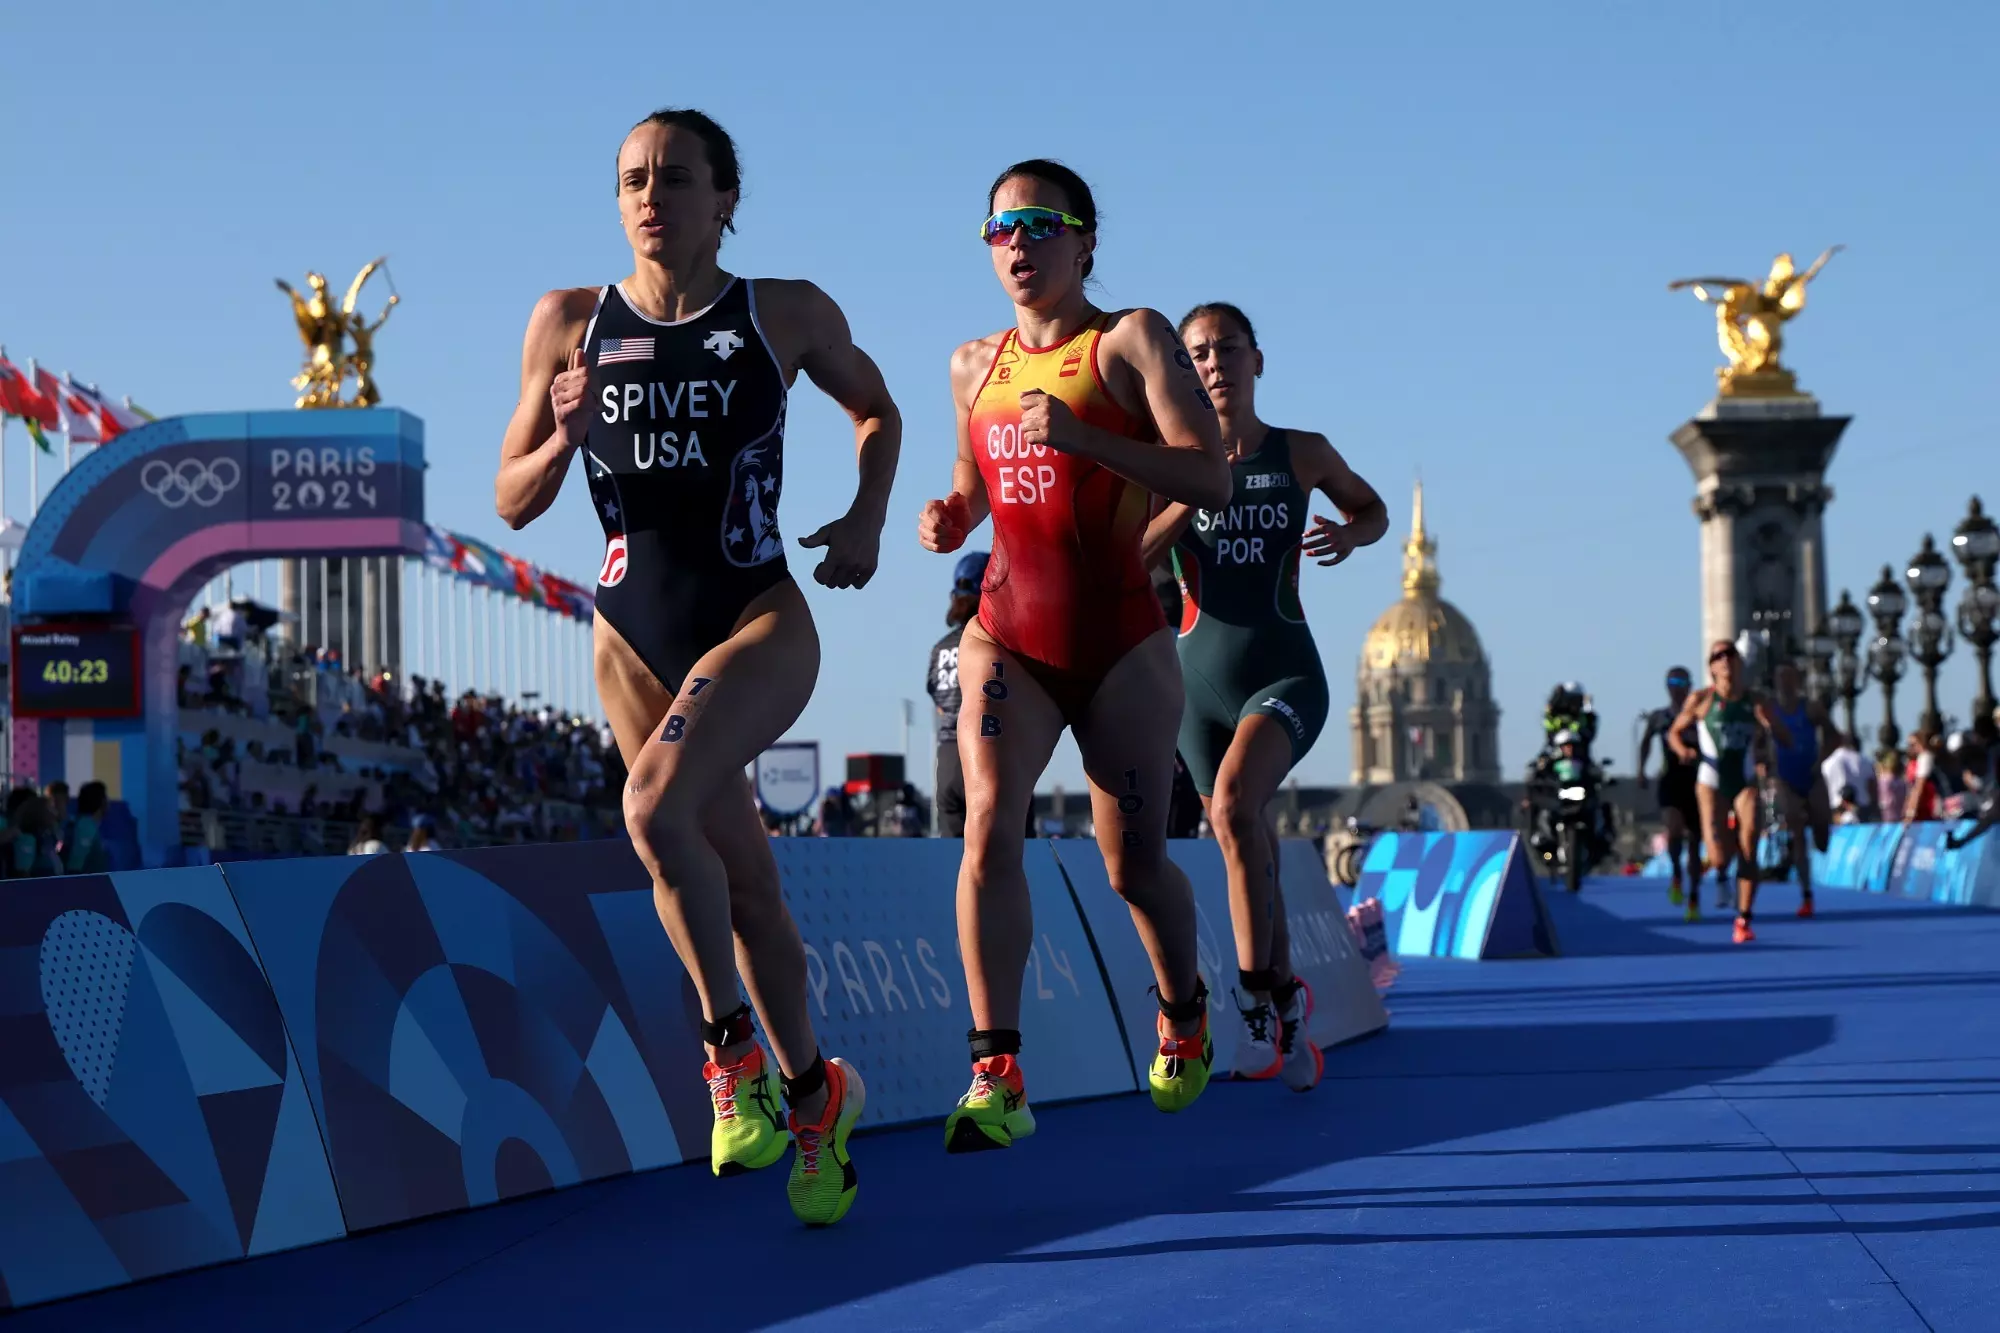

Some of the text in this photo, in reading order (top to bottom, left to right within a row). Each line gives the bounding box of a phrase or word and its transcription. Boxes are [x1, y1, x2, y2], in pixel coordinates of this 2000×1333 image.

[601, 380, 738, 424] SPIVEY
[634, 430, 709, 470] USA
[987, 423, 1059, 460] GOD
[272, 480, 377, 511] 2024
[998, 465, 1056, 505] ESP
[1196, 502, 1289, 532] SANTOS
[1217, 537, 1266, 565] POR
[42, 659, 108, 684] 40:23
[687, 676, 714, 697] 7
[658, 713, 688, 744] B
[980, 713, 1003, 738] B
